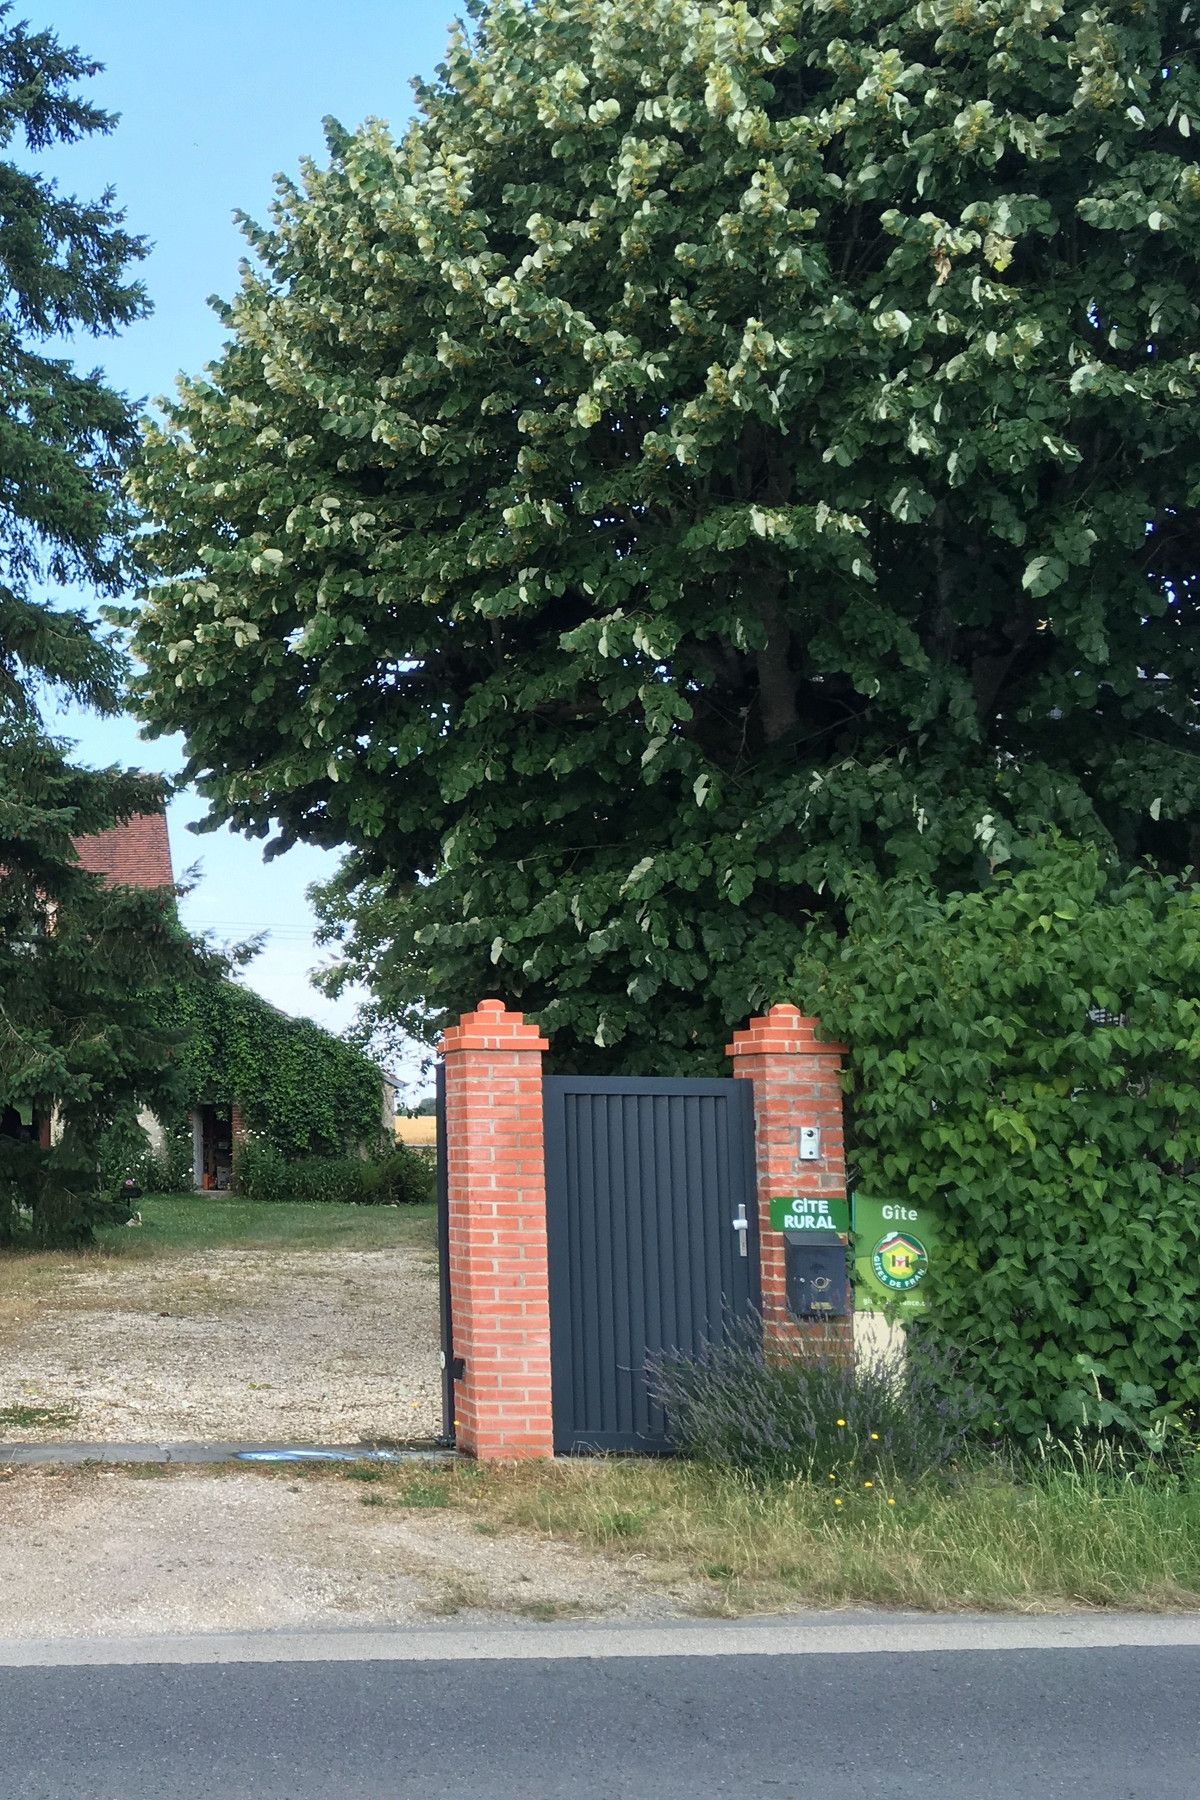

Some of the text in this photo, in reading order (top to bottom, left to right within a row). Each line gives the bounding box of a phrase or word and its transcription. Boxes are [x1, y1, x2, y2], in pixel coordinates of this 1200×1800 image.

[882, 1204, 918, 1221] Gîte
[784, 1215, 836, 1229] RURAL
[889, 1280, 901, 1288] DE
[904, 1268, 925, 1287] FRAN
